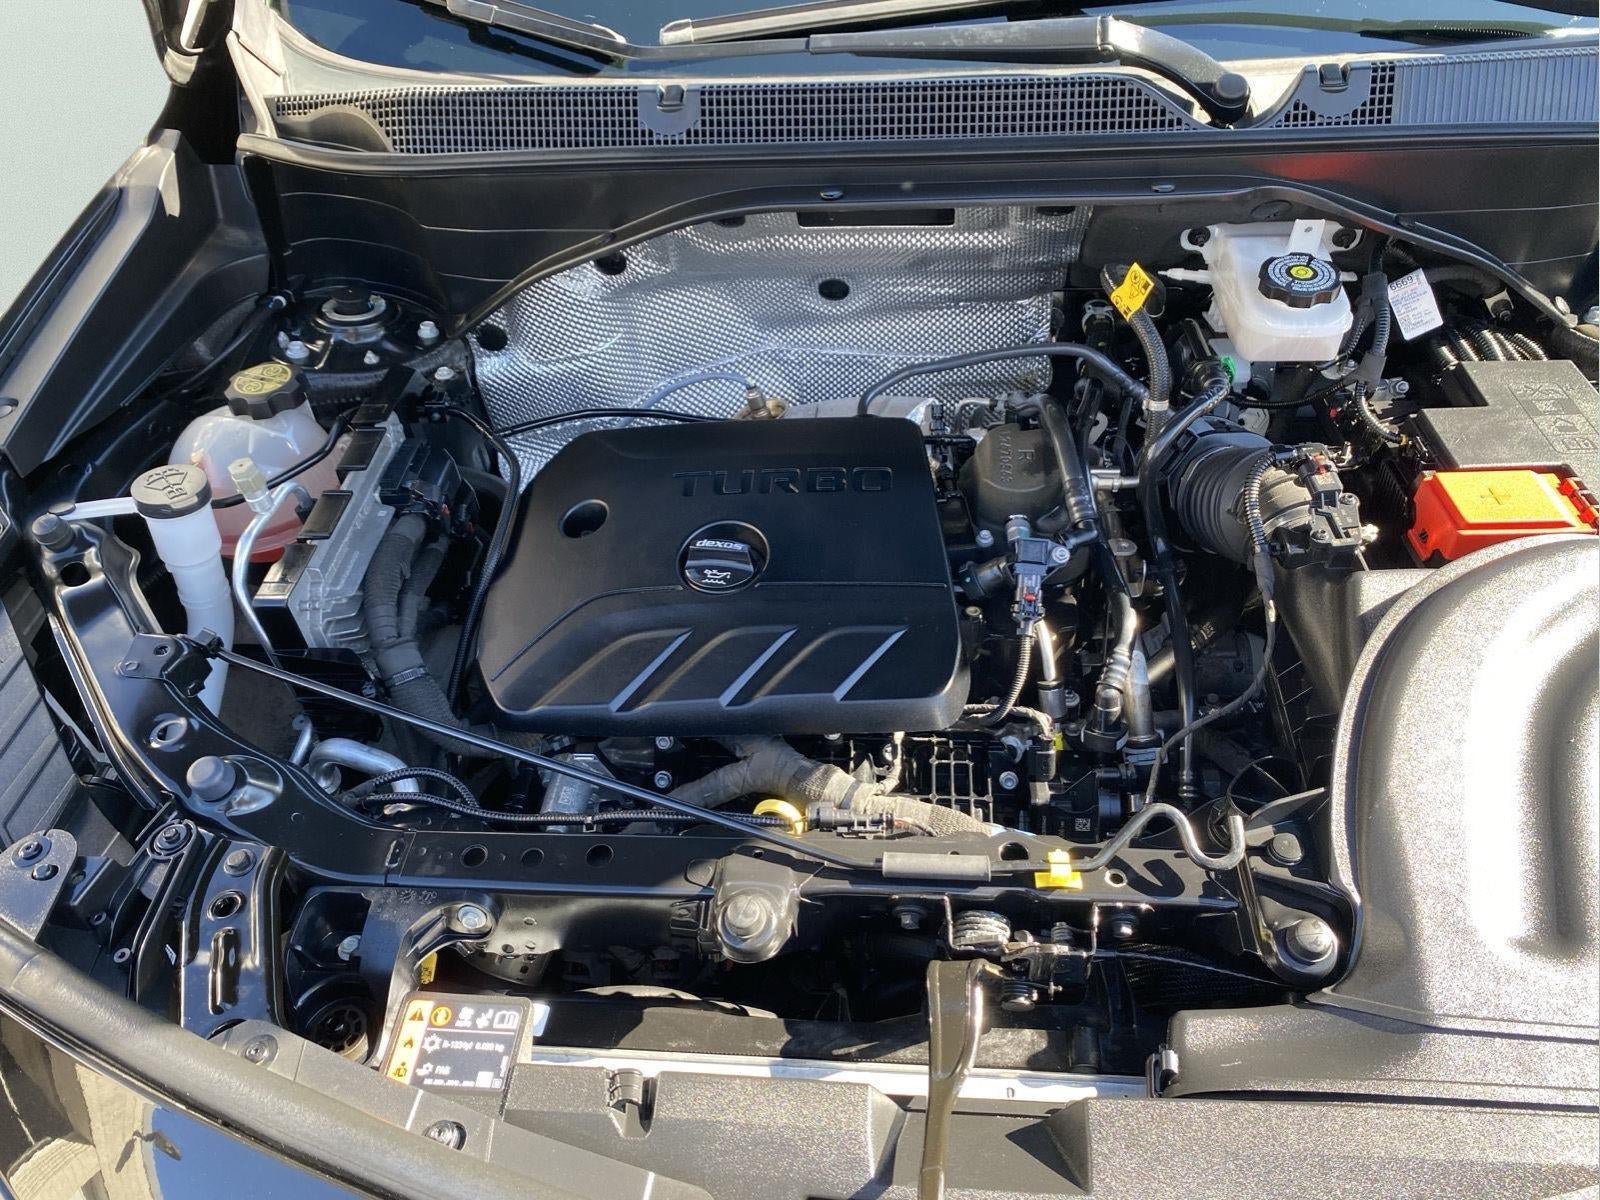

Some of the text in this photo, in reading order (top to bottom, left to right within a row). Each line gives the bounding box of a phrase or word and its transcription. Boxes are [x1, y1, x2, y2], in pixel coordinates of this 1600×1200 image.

[1390, 276, 1413, 291] 6669
[672, 466, 893, 497] TURBO
[696, 539, 745, 551] dexos
